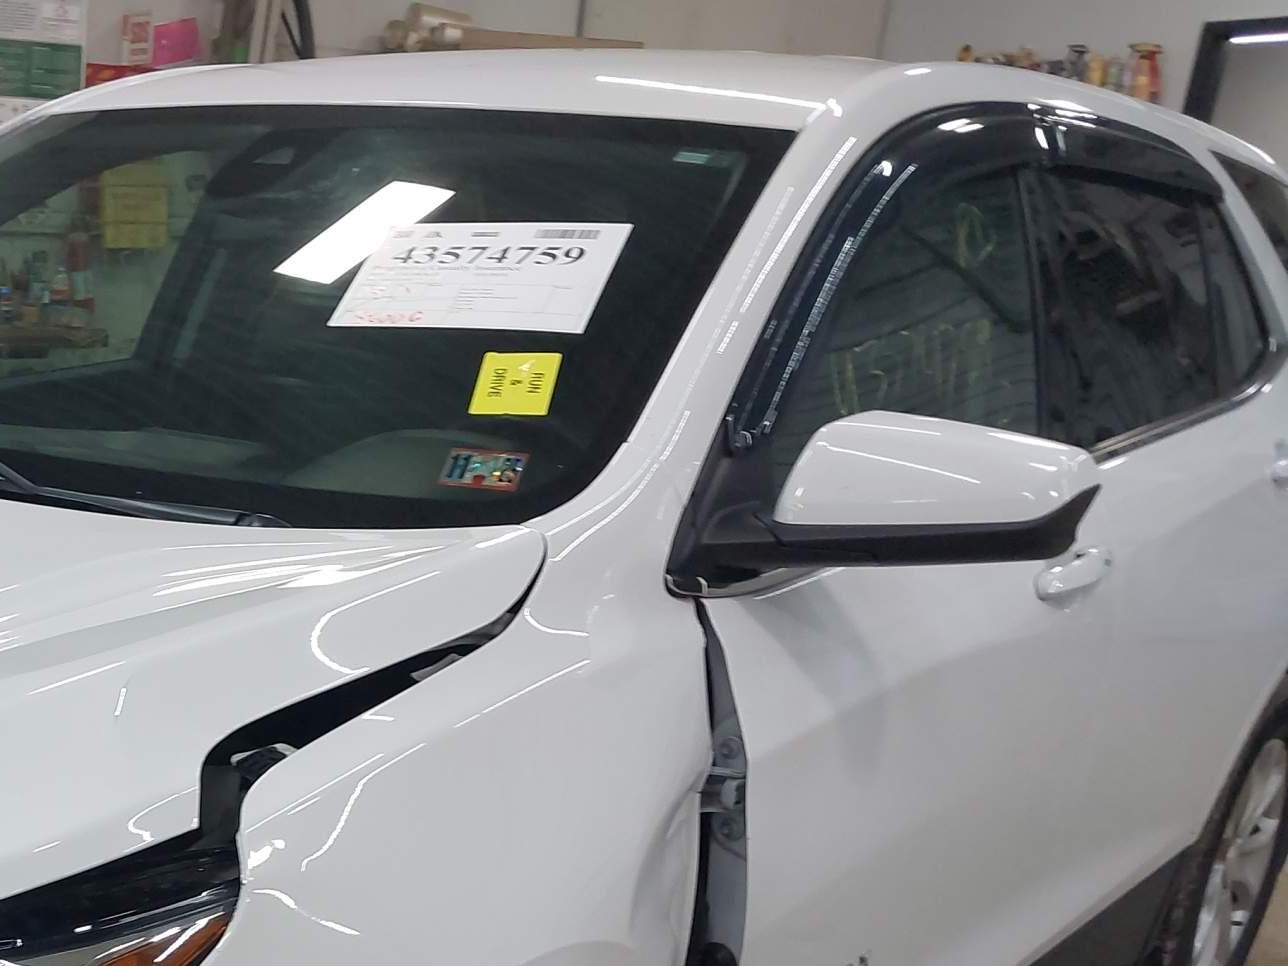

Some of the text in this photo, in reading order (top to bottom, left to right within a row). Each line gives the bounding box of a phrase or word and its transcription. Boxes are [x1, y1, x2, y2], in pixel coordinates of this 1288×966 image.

[391, 246, 587, 266] 43574759
[487, 368, 508, 397] DRIVE
[526, 372, 545, 394] RUN
